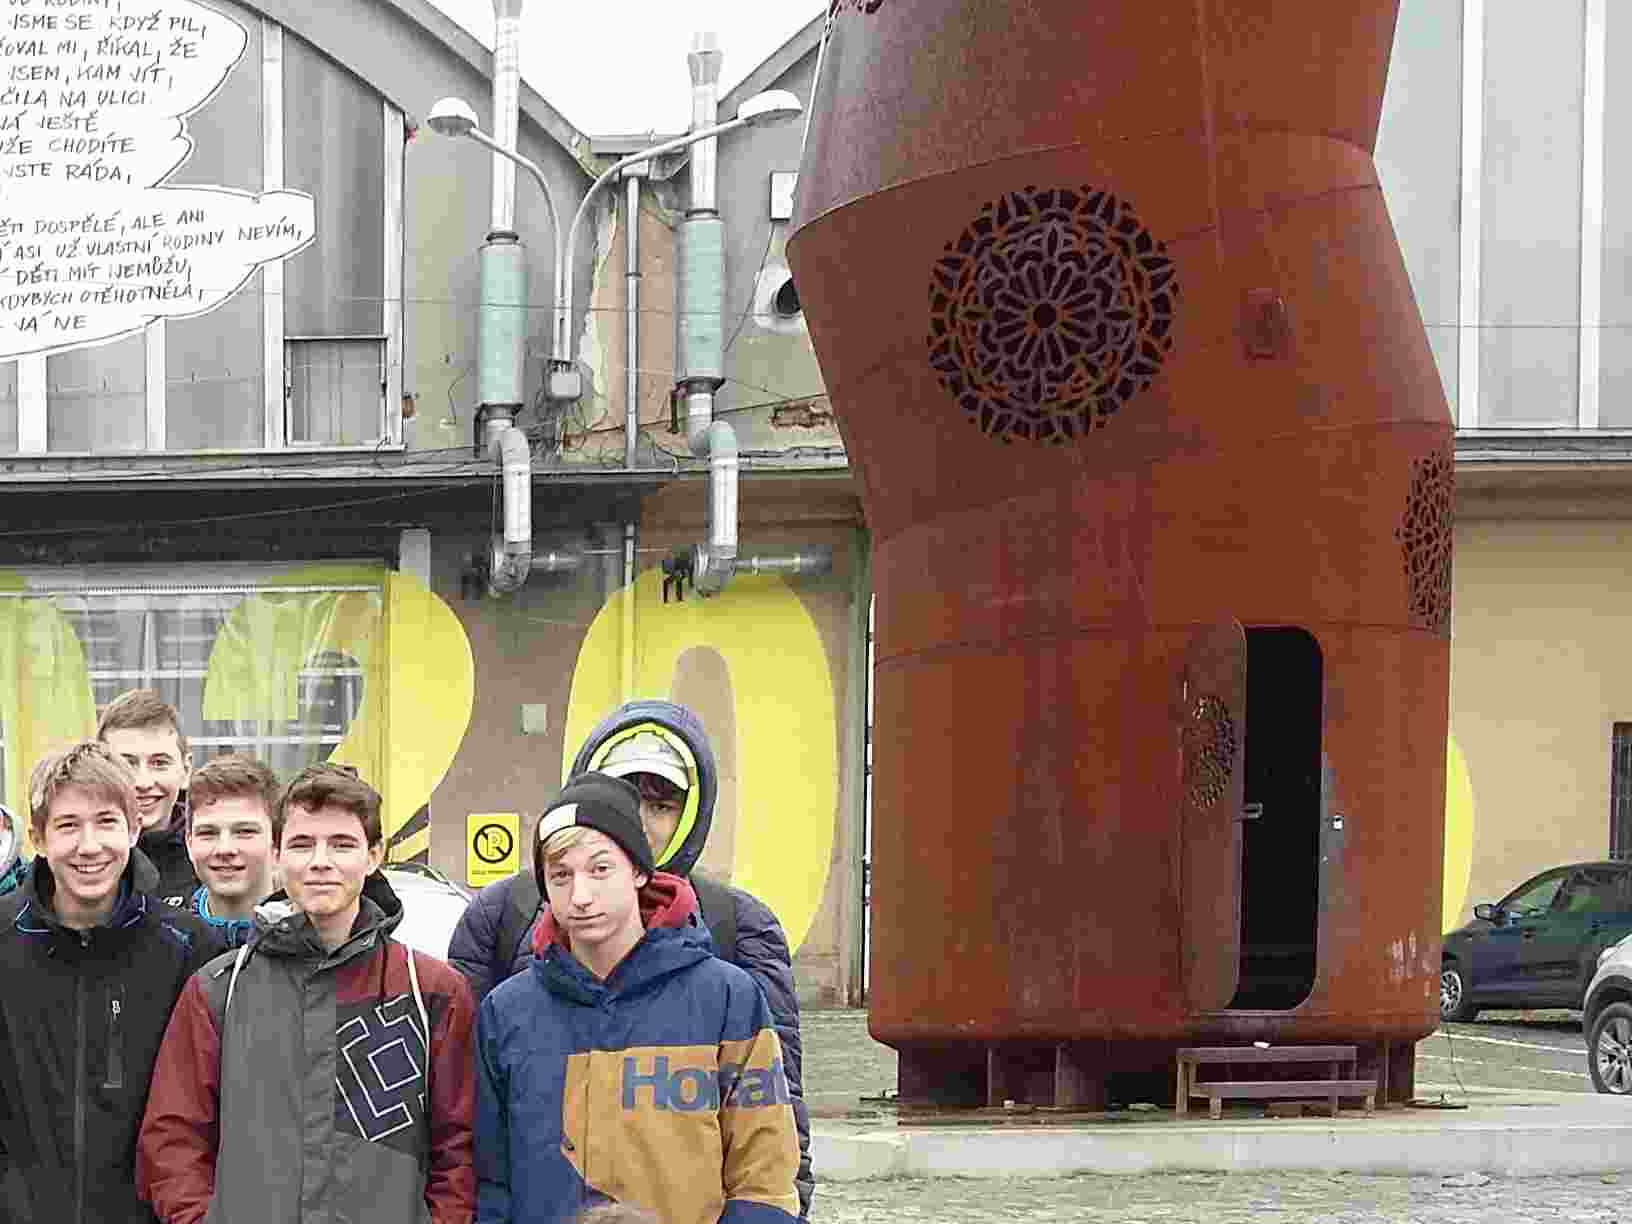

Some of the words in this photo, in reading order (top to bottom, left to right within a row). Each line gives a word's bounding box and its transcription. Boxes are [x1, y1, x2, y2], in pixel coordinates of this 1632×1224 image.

[65, 14, 93, 31] SE
[110, 9, 163, 32] KDYŽ
[169, 36, 199, 59] ŽE
[60, 90, 87, 108] NA
[132, 213, 167, 232] ALE
[176, 208, 205, 225] ANI
[54, 314, 88, 331] NE
